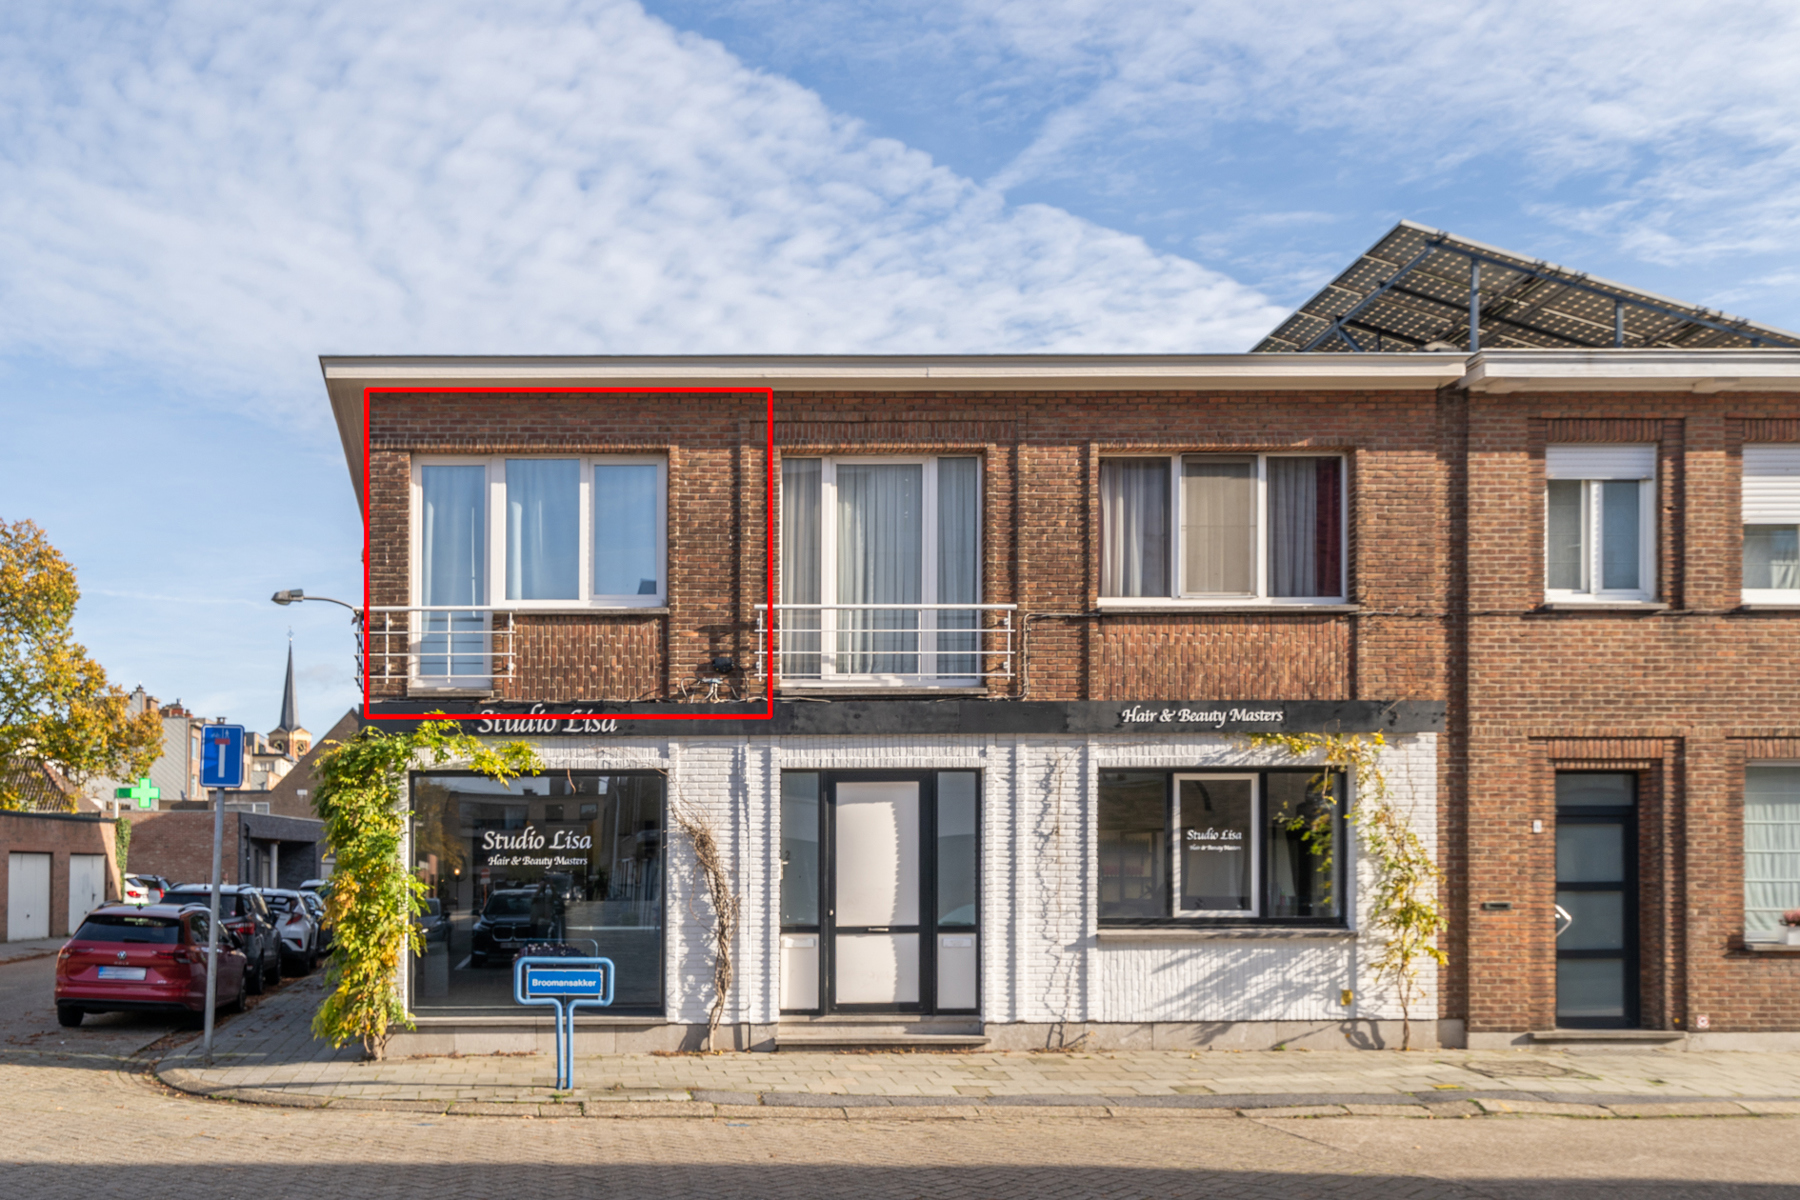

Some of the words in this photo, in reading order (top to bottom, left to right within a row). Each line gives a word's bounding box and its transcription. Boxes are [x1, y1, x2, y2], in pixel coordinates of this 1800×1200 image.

[477, 703, 557, 733] Studio
[562, 709, 618, 733] Lisa
[1122, 705, 1157, 723] Hair
[1159, 708, 1176, 722] &
[1177, 708, 1226, 728] Beauty
[1229, 708, 1283, 722] Masters
[482, 826, 545, 850] Studio
[548, 830, 592, 850] Lisa
[1186, 827, 1219, 840] Studio
[1220, 829, 1242, 840] Lisa
[488, 854, 510, 866] Hair
[510, 856, 522, 866] &
[522, 856, 553, 869] Beauty
[554, 856, 588, 866] Masters
[531, 978, 597, 987] Broomansakker
